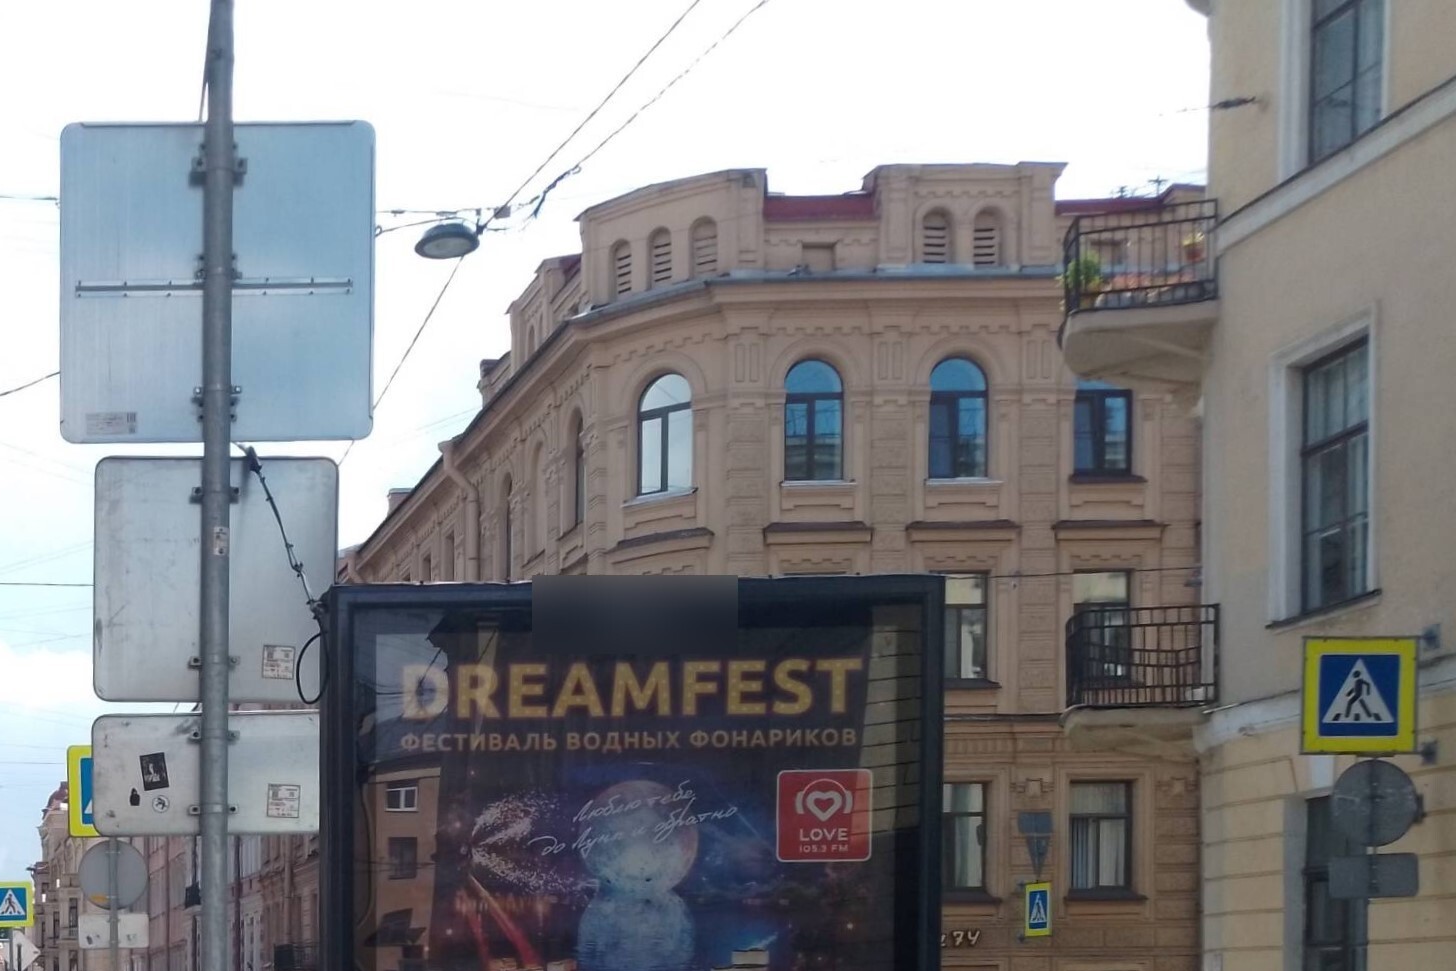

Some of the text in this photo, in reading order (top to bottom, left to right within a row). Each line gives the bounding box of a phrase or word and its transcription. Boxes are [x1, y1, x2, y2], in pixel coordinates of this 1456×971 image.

[400, 656, 863, 720] DREAMFEST
[400, 727, 857, 753] ФЕСТИВАЛЬ ВОДНЫХ ФОНАРИКОВ
[799, 828, 849, 842] LOVE
[830, 844, 849, 853] FM
